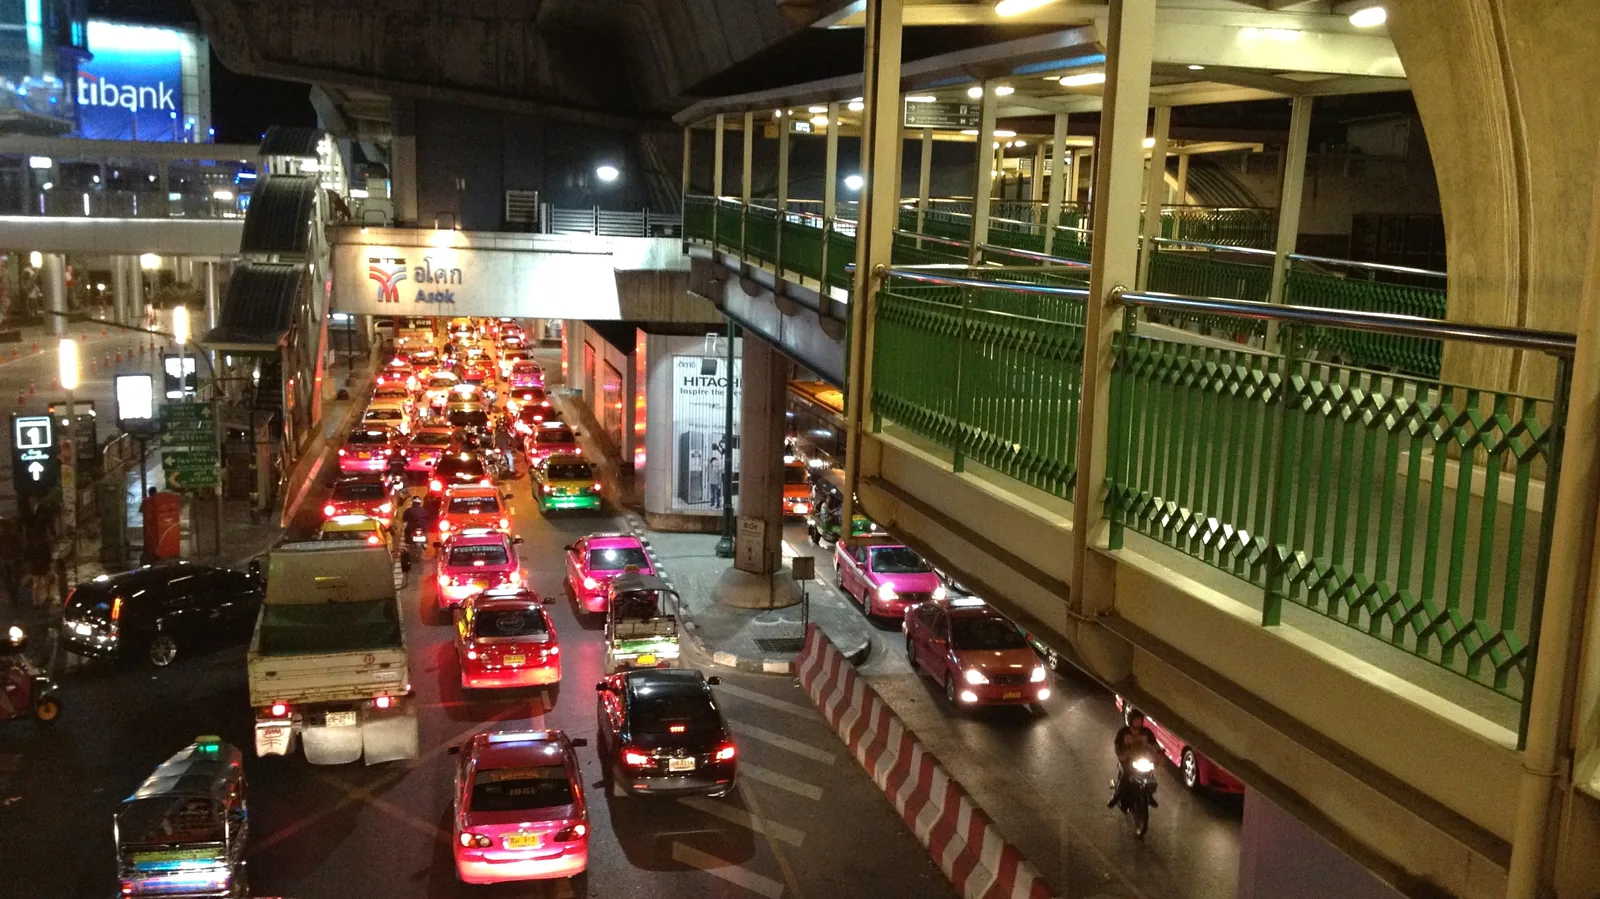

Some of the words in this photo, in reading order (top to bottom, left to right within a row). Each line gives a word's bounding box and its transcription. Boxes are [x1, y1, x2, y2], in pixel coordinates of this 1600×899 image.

[414, 288, 455, 304] Asok
[680, 388, 709, 397] Inspire
[27, 427, 40, 446] 1
